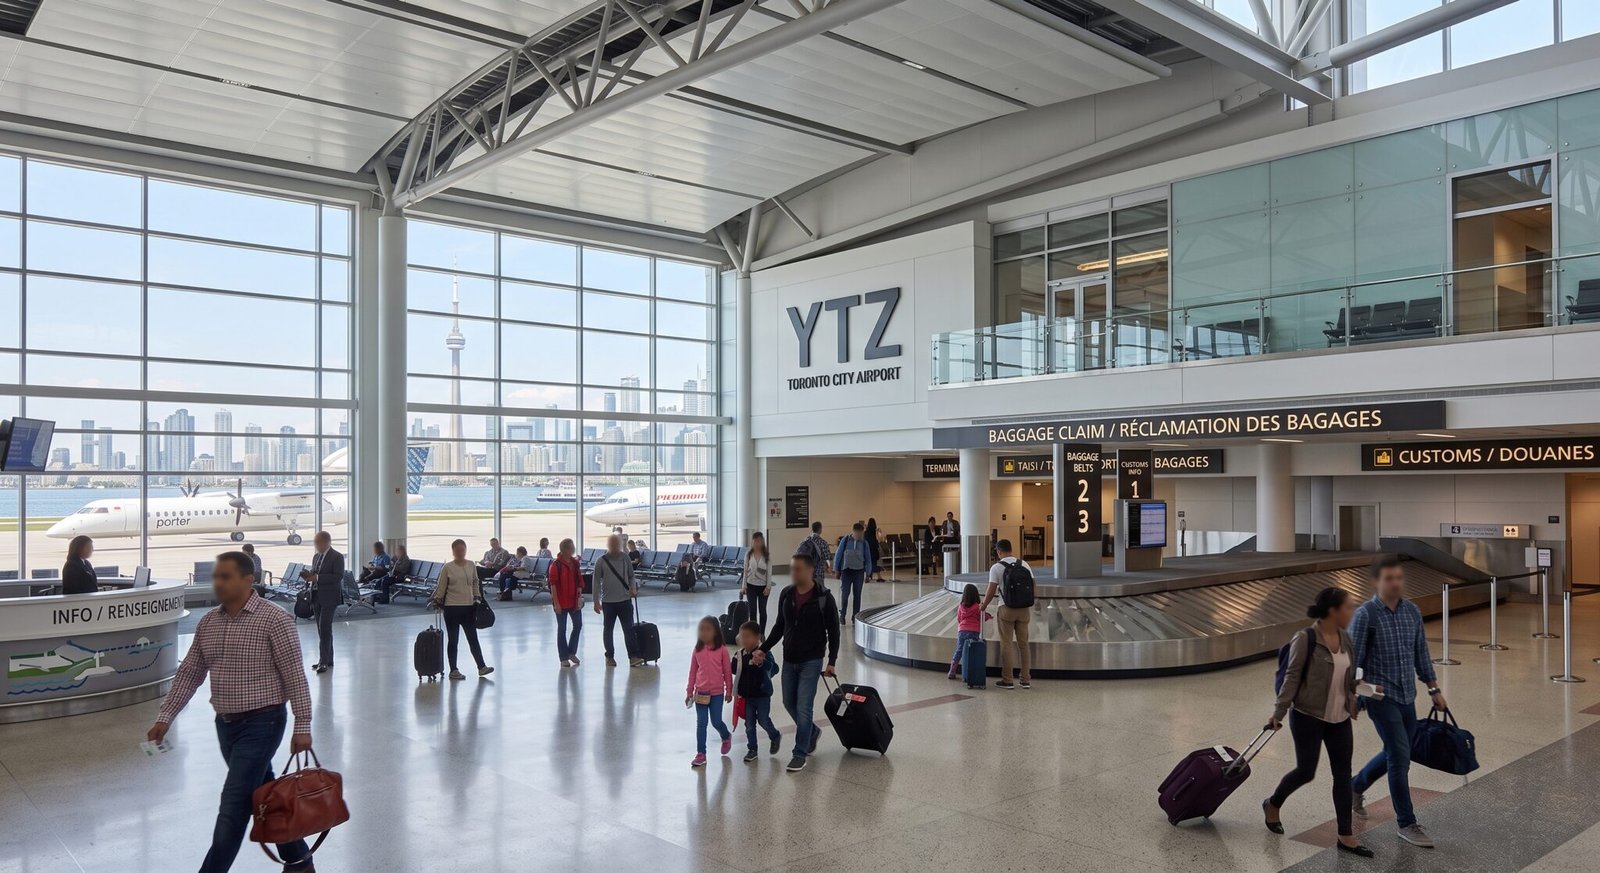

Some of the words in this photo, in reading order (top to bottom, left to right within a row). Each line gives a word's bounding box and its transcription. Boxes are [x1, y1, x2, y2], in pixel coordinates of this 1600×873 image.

[786, 287, 902, 368] YTZ
[787, 375, 830, 391] TORONTO
[832, 371, 855, 386] CITY
[856, 366, 902, 384] AIRPORT
[989, 426, 1054, 443] BAGGAGE
[1058, 424, 1105, 440] CLAIM
[1109, 423, 1116, 439] /
[1120, 417, 1240, 438] RÉCLAMATION
[1246, 415, 1280, 433] DES
[1287, 409, 1382, 431] BAGAGES
[1017, 461, 1038, 471] TAISI
[1154, 456, 1209, 469] BAGAGES
[1067, 452, 1099, 461] BAGGAGE
[1399, 448, 1482, 464] CUSTOMS
[1487, 447, 1494, 462] /
[1500, 445, 1595, 462] DOUANES
[925, 463, 960, 473] TERMINA
[1073, 463, 1094, 473] BELTS
[1128, 468, 1142, 476] INFO
[1077, 479, 1089, 503] 2
[1131, 480, 1140, 499] 1
[156, 516, 191, 529] porter
[1078, 509, 1089, 534] 3
[53, 607, 92, 625] INFO
[96, 606, 103, 621] /
